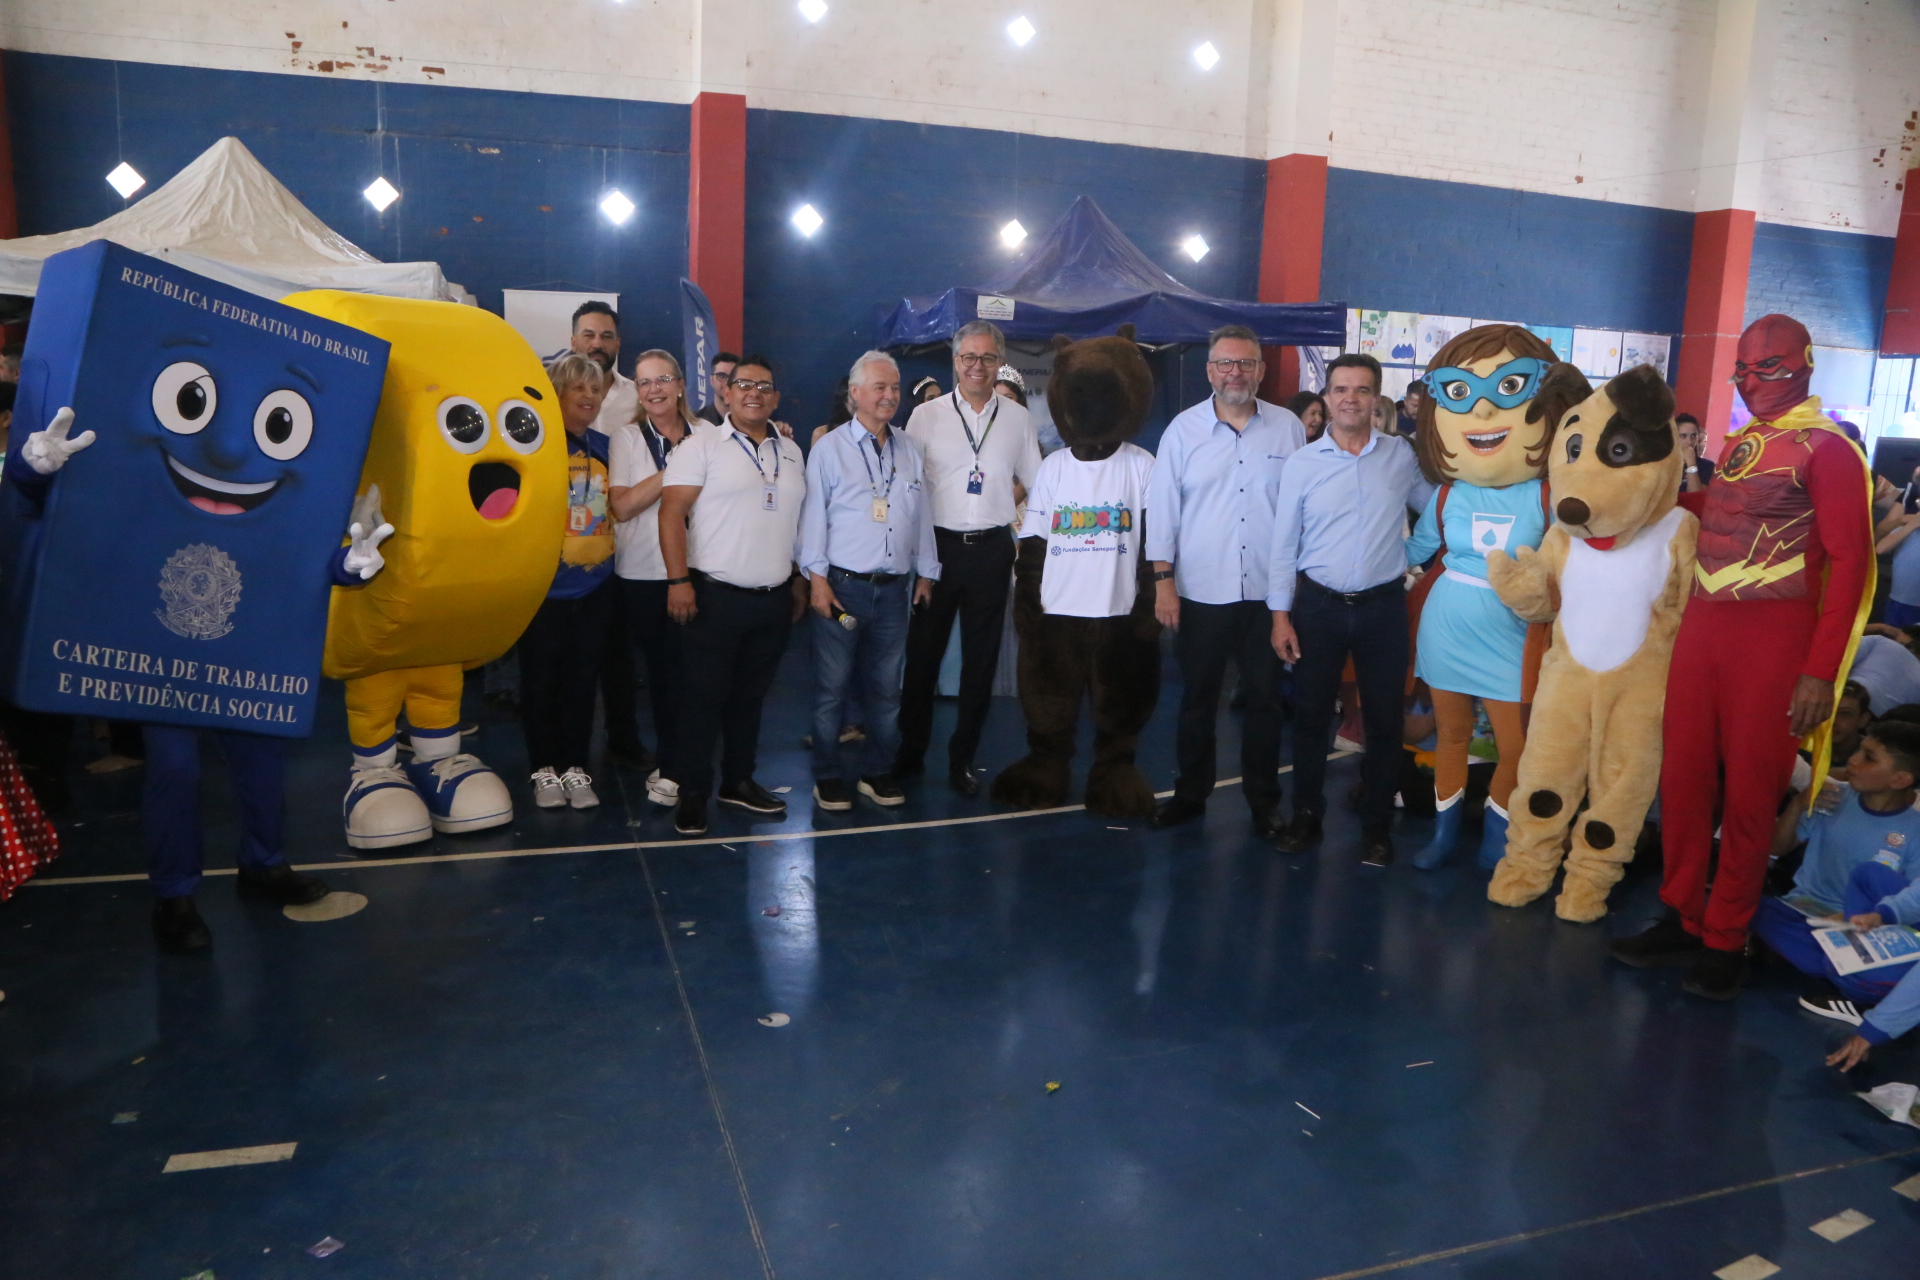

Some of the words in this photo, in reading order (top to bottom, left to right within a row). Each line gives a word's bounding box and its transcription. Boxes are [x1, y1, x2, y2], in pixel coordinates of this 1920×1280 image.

[121, 266, 208, 310] REPÚBLICA
[212, 299, 298, 341] FEDERATIVA
[302, 330, 321, 348] DO
[324, 338, 370, 365] BRASIL
[694, 316, 707, 410] NEPAR
[1051, 510, 1131, 529] FUNDOCA
[53, 639, 164, 675] CARTEIRA
[171, 659, 198, 680] DE
[205, 664, 309, 695] TRABALHO
[58, 673, 72, 693] E
[80, 676, 221, 714] PREVIDÊNCIA
[227, 699, 297, 723] SOCIAL
